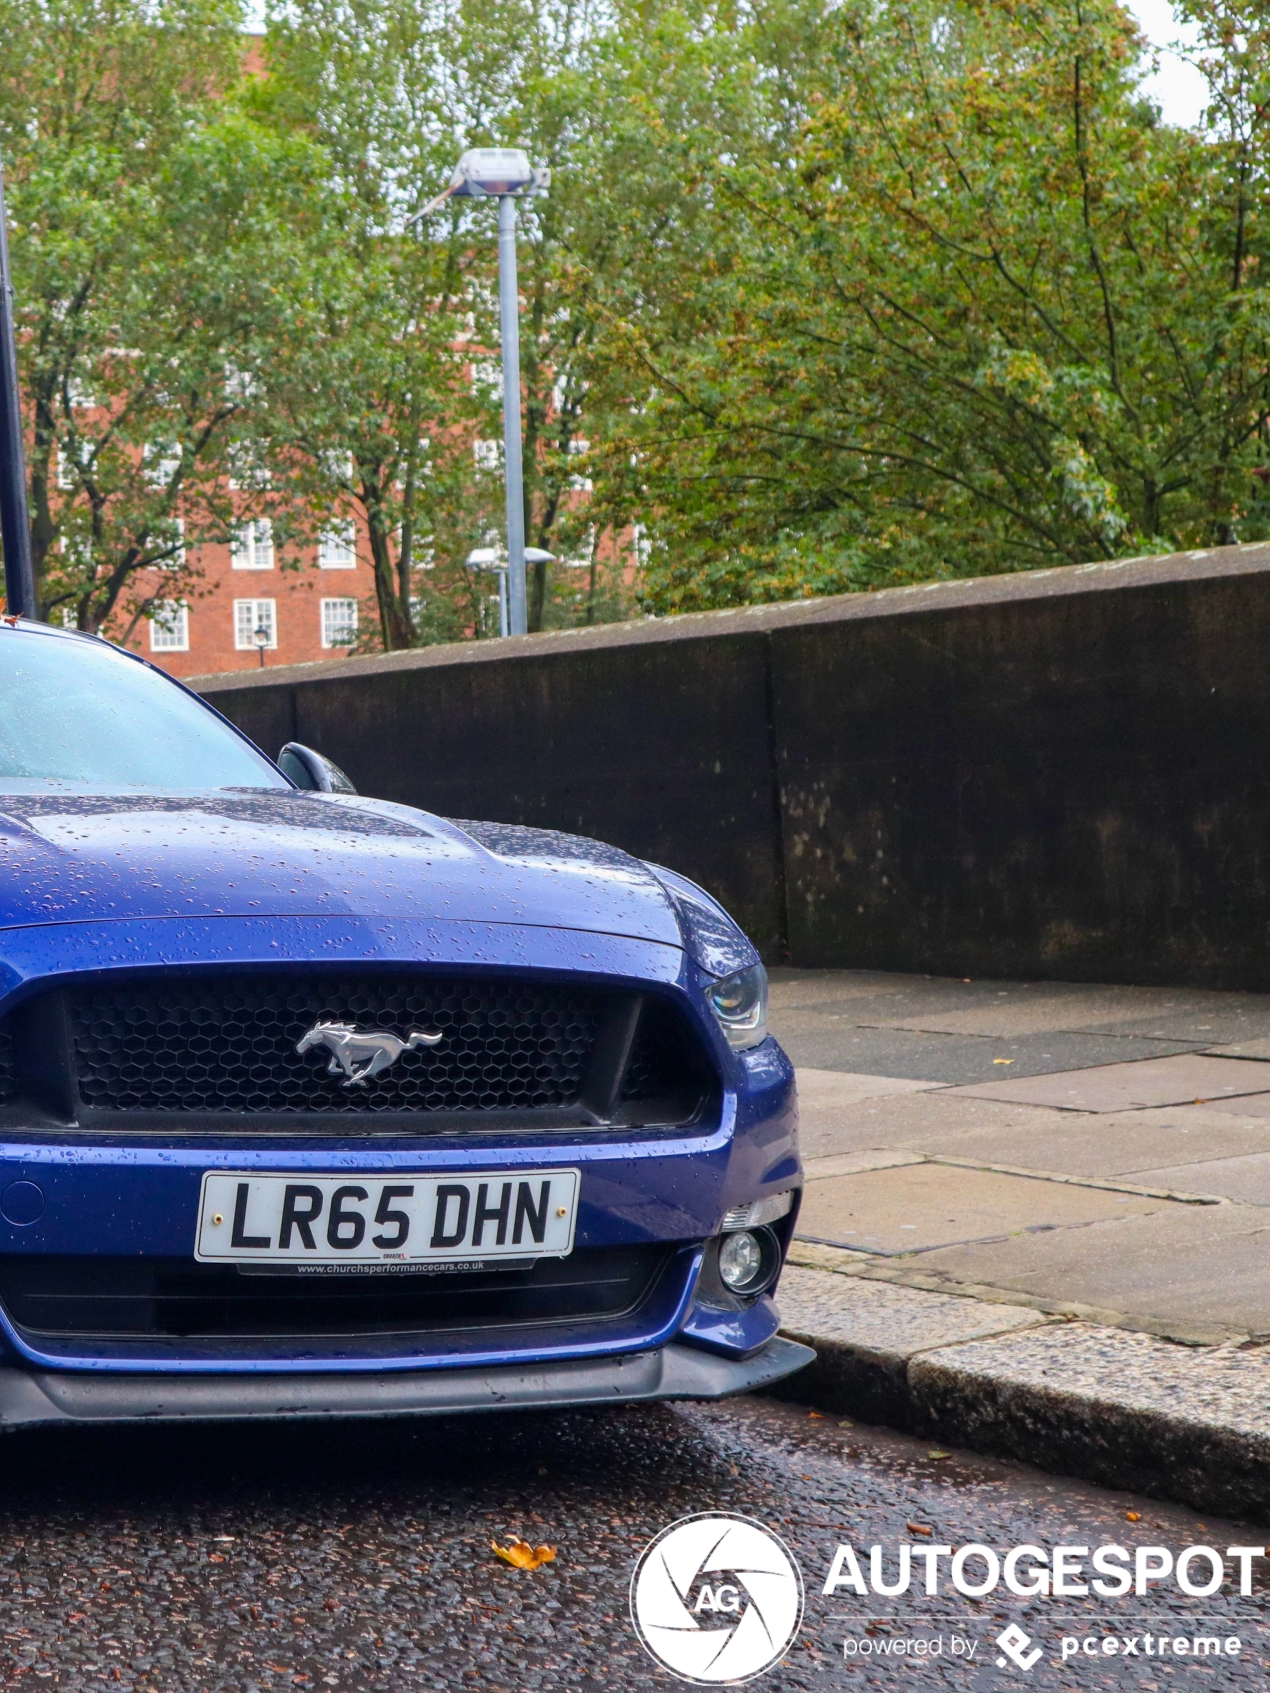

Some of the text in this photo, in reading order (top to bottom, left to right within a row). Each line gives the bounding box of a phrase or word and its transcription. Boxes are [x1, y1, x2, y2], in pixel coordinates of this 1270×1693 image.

[230, 1180, 552, 1250] LR65 DHN
[297, 1261, 484, 1274] www.churchsperformancecars.co.uk
